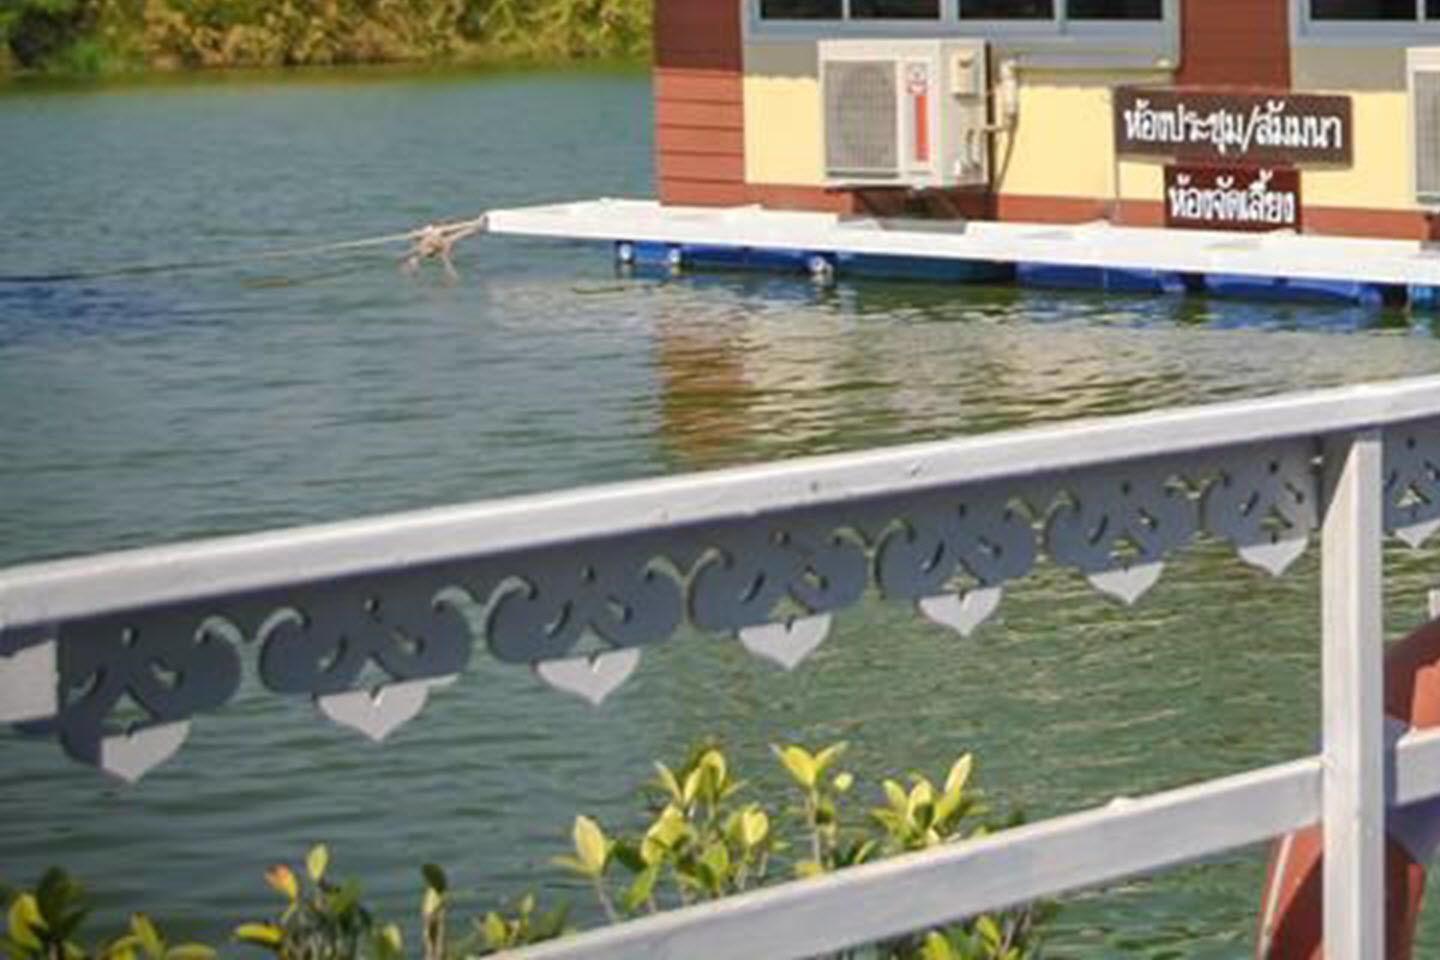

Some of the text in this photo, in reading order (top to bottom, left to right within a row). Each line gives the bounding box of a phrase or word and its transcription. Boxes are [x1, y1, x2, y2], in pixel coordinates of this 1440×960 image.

[1123, 98, 1343, 154] ห้องประชุม/สัมมนา
[1168, 169, 1296, 224] ห้องจัดเลี้ยง
